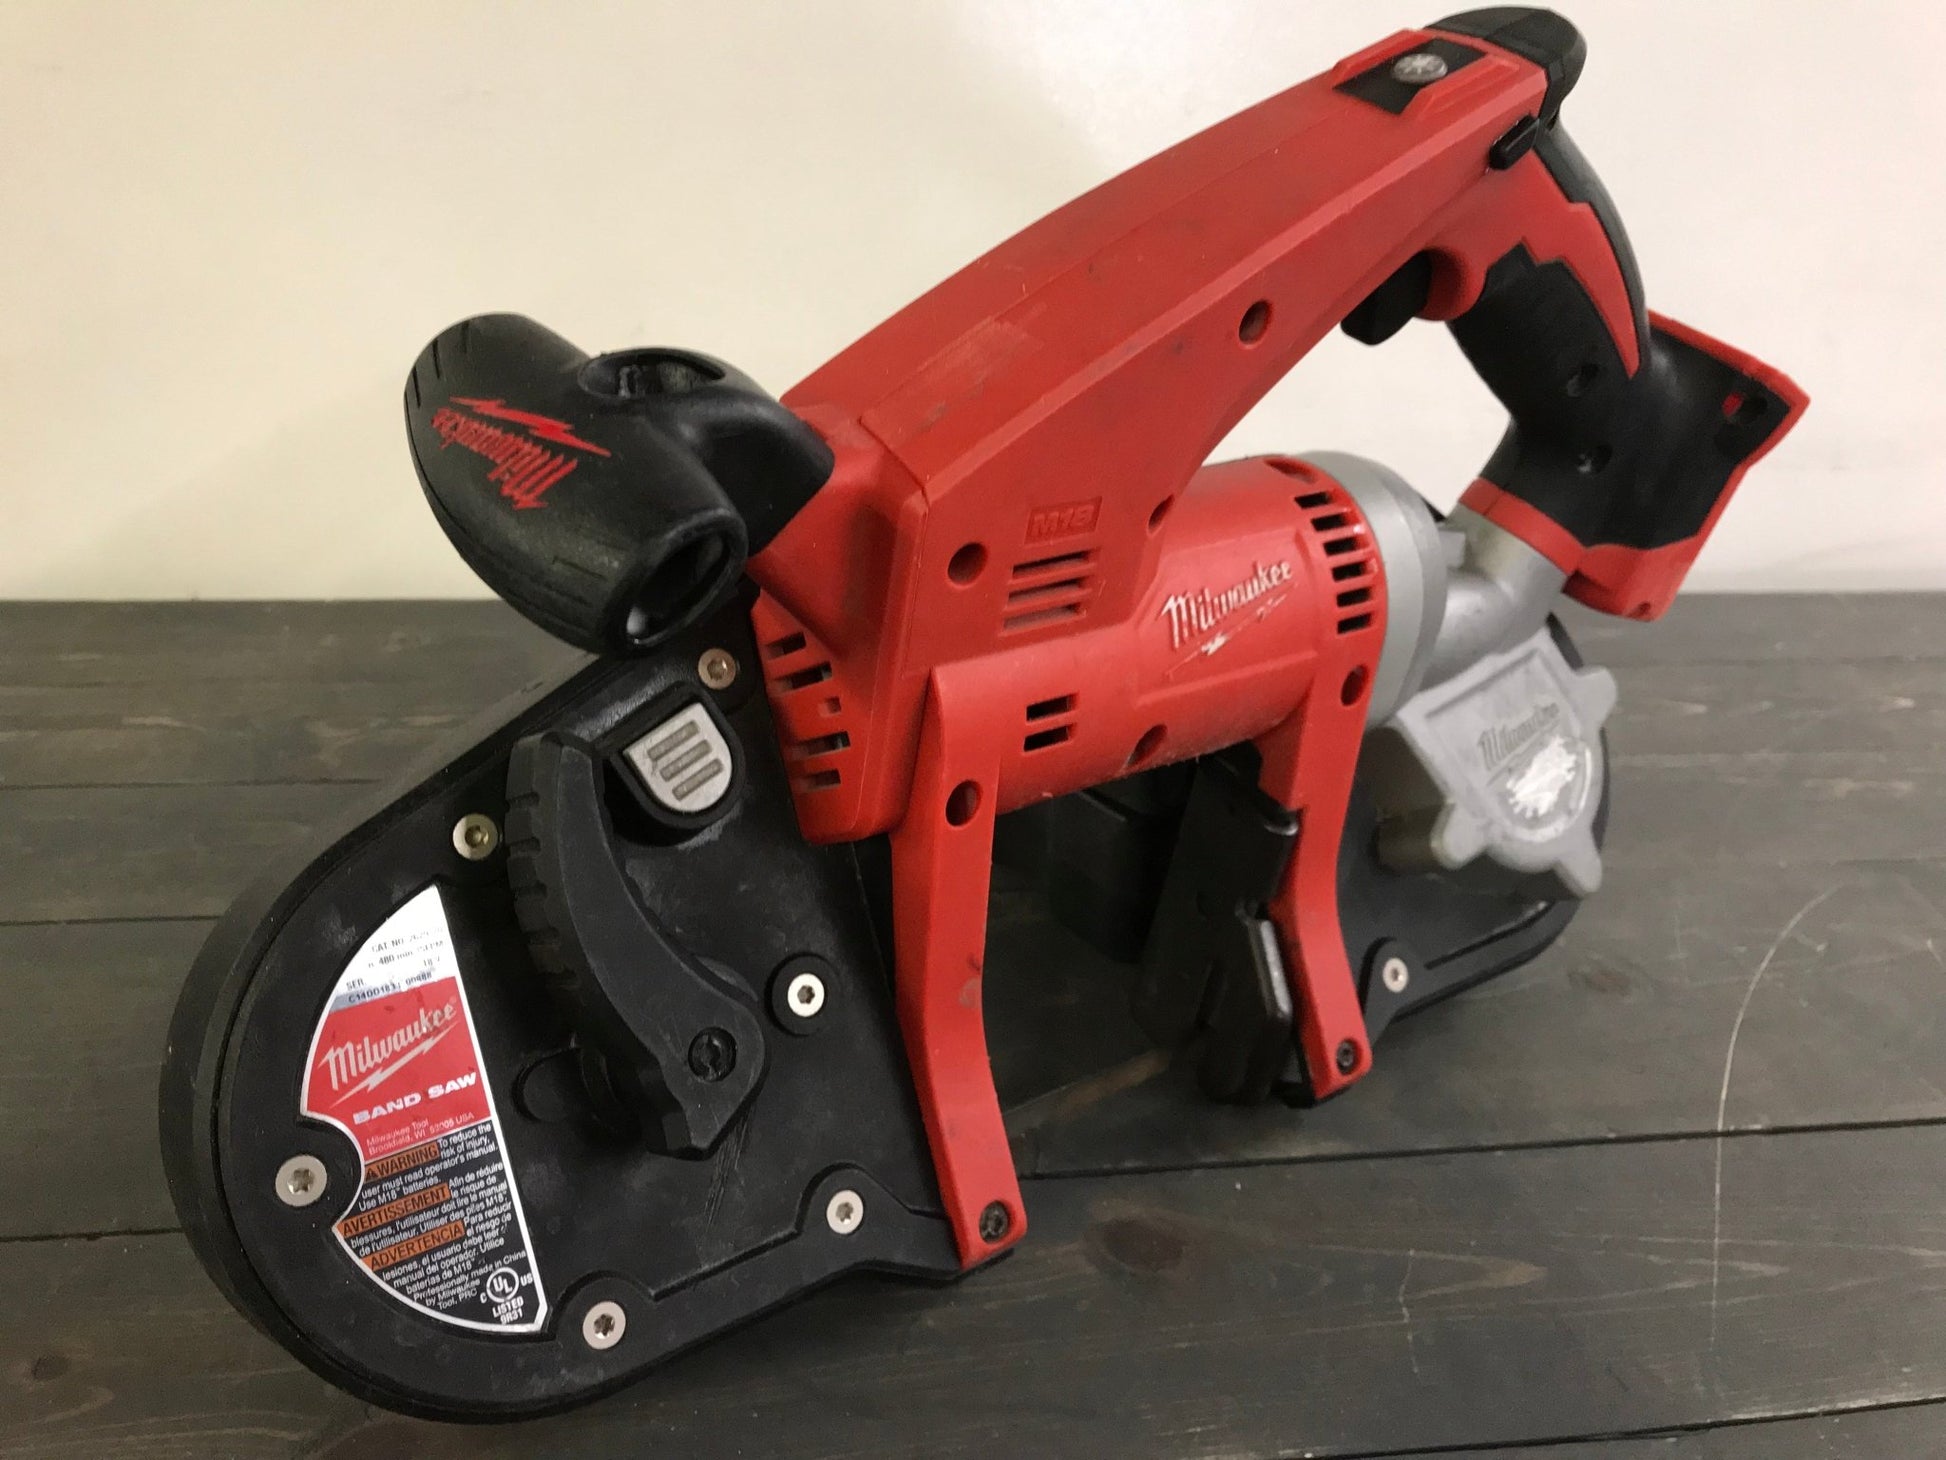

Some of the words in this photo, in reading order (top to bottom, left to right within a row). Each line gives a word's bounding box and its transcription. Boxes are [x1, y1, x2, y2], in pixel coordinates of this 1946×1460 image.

[431, 407, 578, 510] Milwaukee
[1032, 504, 1096, 535] M18
[1158, 560, 1293, 650] Milwaukee
[317, 1003, 457, 1091] Milwaukee
[353, 1092, 421, 1125] BAND
[428, 1072, 476, 1099] SAW
[367, 1126, 410, 1147] Milwaukee
[412, 1118, 429, 1131] Tool
[455, 1112, 475, 1125] USA
[438, 1138, 448, 1148] To
[449, 1128, 477, 1143] reduce
[478, 1122, 492, 1134] the
[377, 1144, 438, 1176] WARNING
[441, 1147, 456, 1160] risk
[457, 1142, 465, 1153] of
[361, 1186, 380, 1199] user
[382, 1176, 403, 1191] must
[404, 1167, 424, 1182] read
[424, 1154, 465, 1177] operator's
[448, 1176, 464, 1190] Afin
[465, 1169, 475, 1182] de
[450, 1188, 459, 1199] le
[460, 1179, 485, 1196] risque
[486, 1174, 496, 1187] de
[343, 1187, 447, 1236] AVERTISSEMENT
[359, 1199, 377, 1212] Use
[463, 1211, 483, 1227] Para
[484, 1200, 512, 1218] reducir
[351, 1225, 396, 1248] blessures,
[441, 1200, 456, 1214] doit
[359, 1245, 371, 1258] de
[449, 1209, 465, 1222] des
[466, 1225, 474, 1237] el
[475, 1217, 500, 1235] riesgo
[371, 1224, 463, 1270] ADVERTENCIA
[421, 1254, 430, 1266] el
[431, 1242, 461, 1262] usuario
[484, 1228, 500, 1240] leer
[393, 1267, 425, 1289] manual
[426, 1262, 439, 1275] del
[441, 1269, 453, 1281] de
[471, 1263, 493, 1279] made
[494, 1259, 502, 1269] in
[503, 1249, 527, 1265] China
[425, 1296, 437, 1307] by
[438, 1278, 480, 1301] Milwaukee
[520, 1272, 533, 1287] US
[458, 1288, 478, 1302] PRC
[492, 1295, 524, 1318] LISTED
